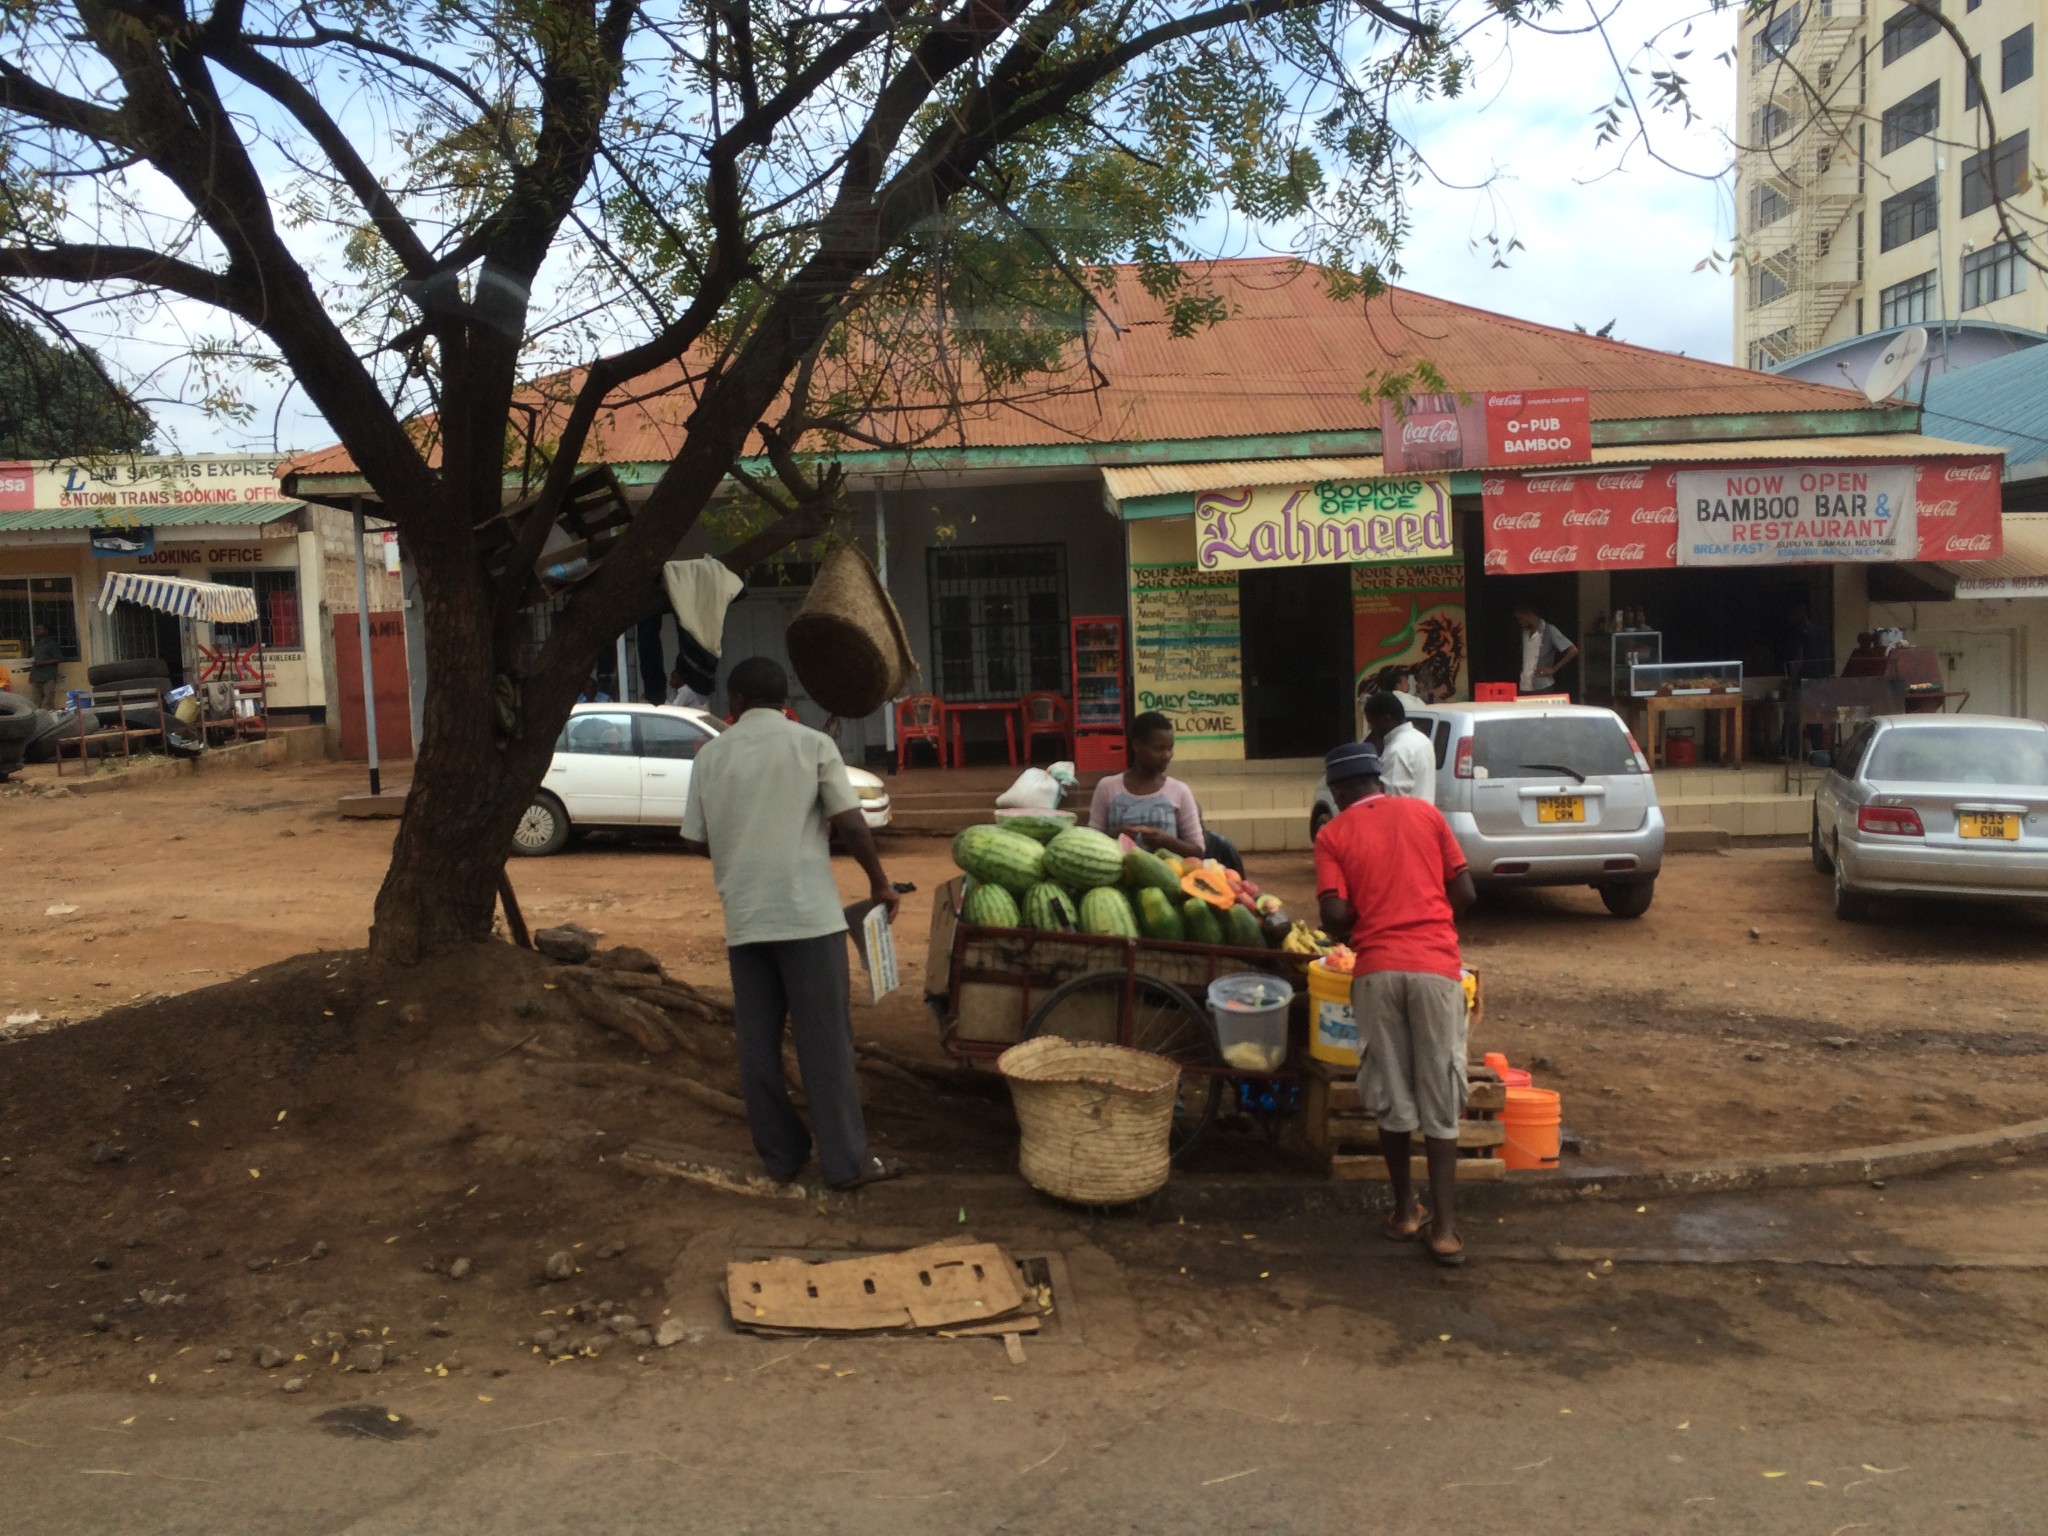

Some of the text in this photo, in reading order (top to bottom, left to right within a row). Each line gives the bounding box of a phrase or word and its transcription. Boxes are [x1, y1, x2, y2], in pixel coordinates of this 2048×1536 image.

[1402, 420, 1458, 446] Coca-Cola
[1504, 437, 1572, 454] BAMBOO
[1314, 480, 1423, 500] BOOKING
[1726, 472, 1869, 497] NOW OPEN
[120, 491, 170, 505] TRANS
[174, 489, 237, 504] BOOKING
[1320, 495, 1414, 515] OFFICE
[1696, 492, 1891, 522] BAMBOO BAR &
[1493, 512, 1542, 530] Coca-Cola
[1563, 508, 1611, 526] Coca-Cola
[1732, 519, 1888, 542] RESTAURANT
[1597, 543, 1646, 560] Coca-Cola
[1945, 534, 1993, 551] Coca-Cola
[138, 548, 263, 565] BOOKING OFFICE
[1529, 545, 1579, 564] Coca-Cola
[1134, 567, 1169, 581] YOUR
[1354, 564, 1463, 582] YOUR COMFORT
[1137, 576, 1236, 589] OUR CONCERN
[1396, 576, 1464, 589] PRIORITY
